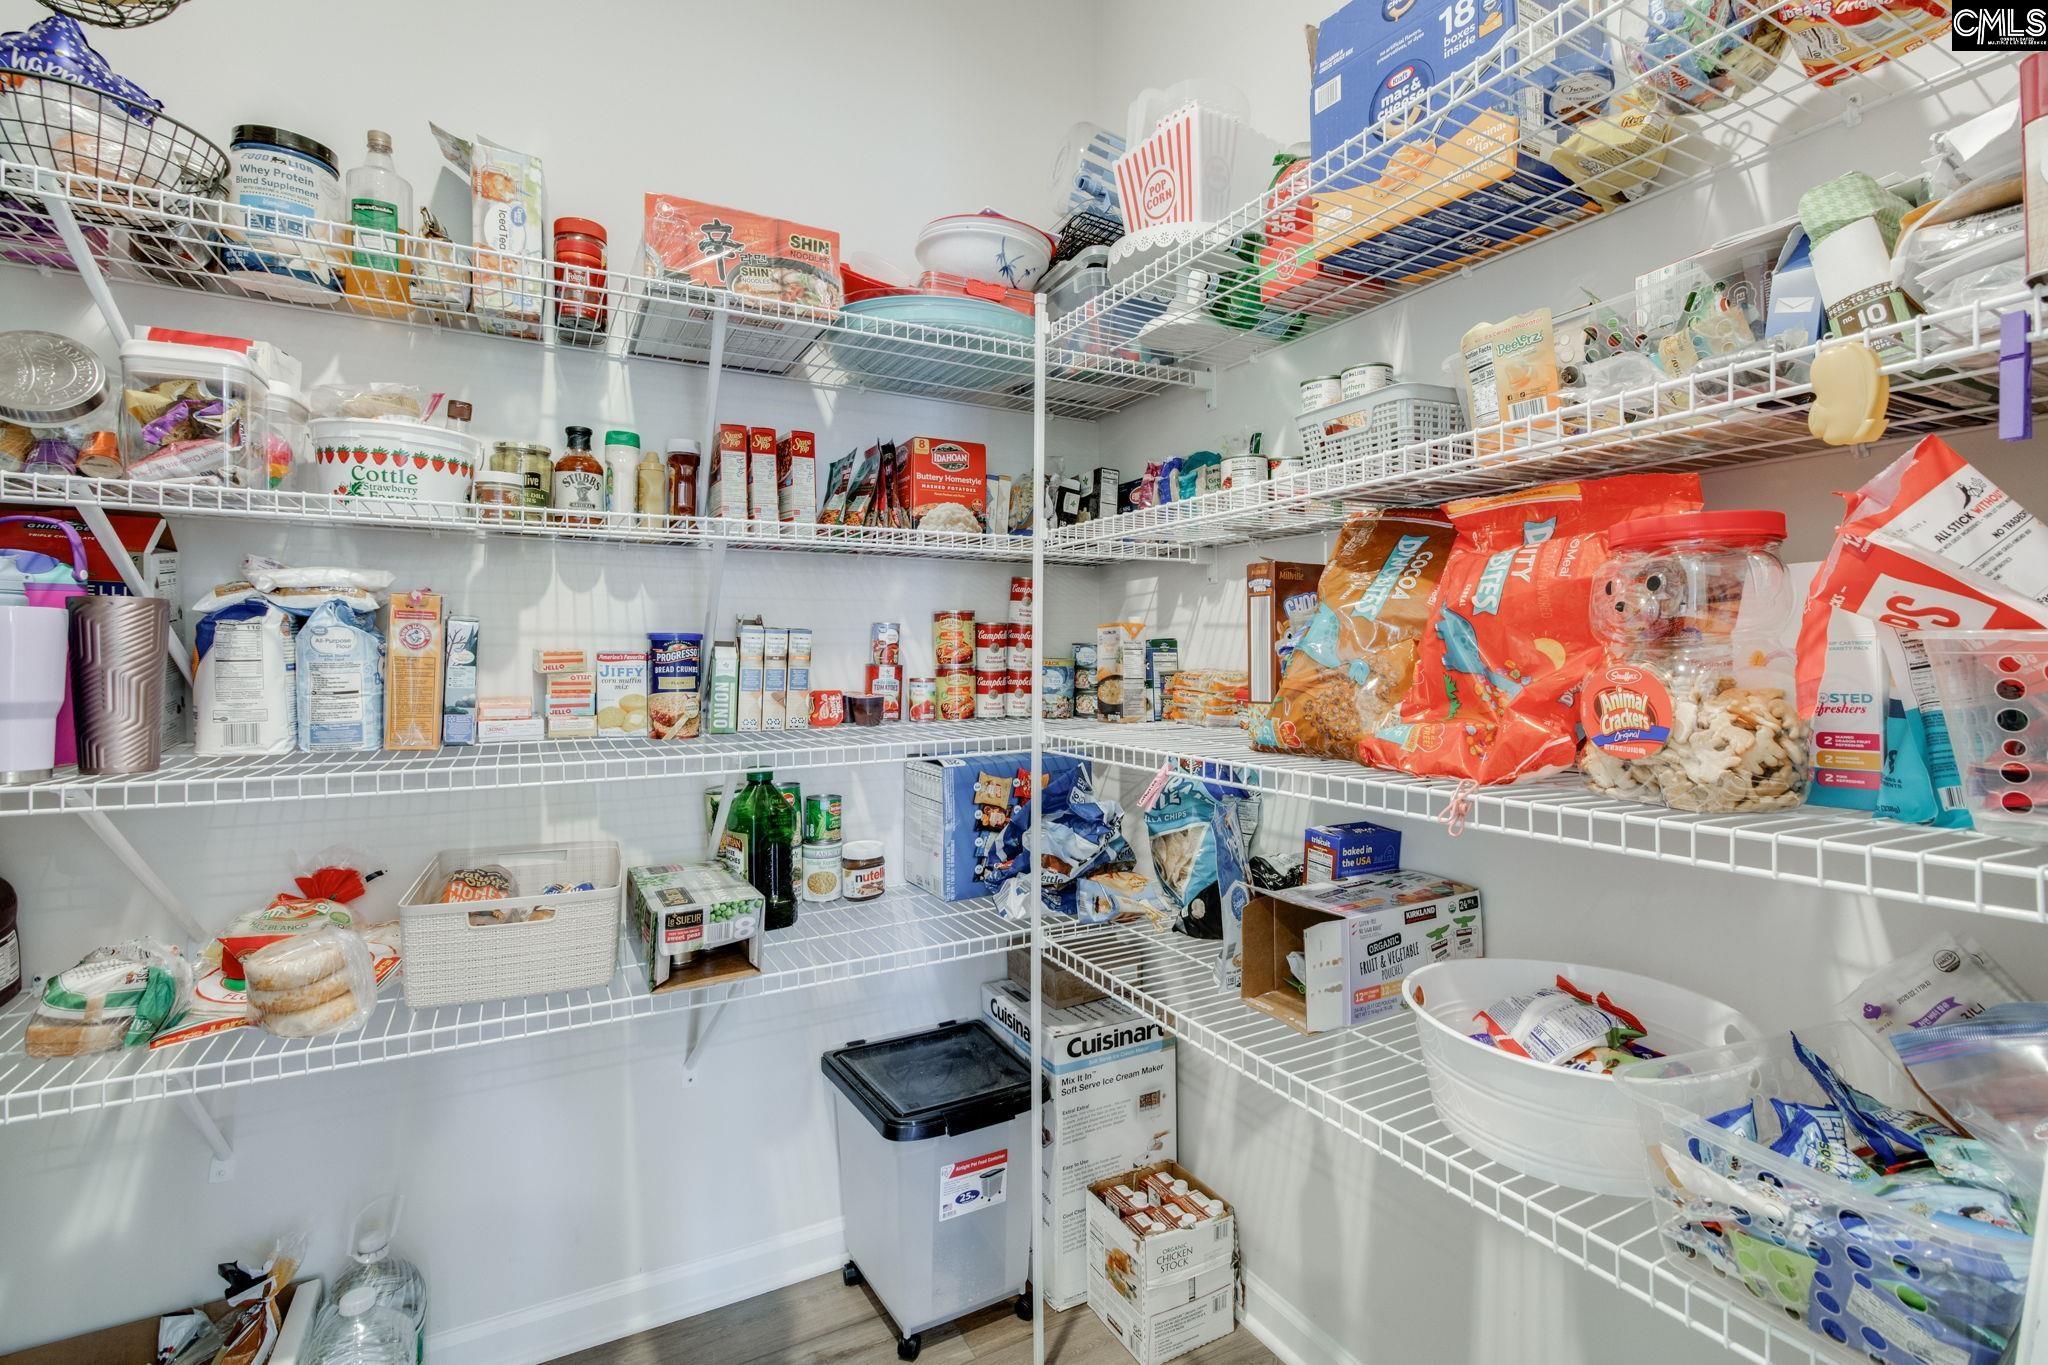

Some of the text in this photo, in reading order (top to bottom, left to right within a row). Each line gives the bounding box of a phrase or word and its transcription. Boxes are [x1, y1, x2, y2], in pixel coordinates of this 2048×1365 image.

[1438, 0, 1475, 35] 18
[1443, 24, 1475, 48] boxes
[1444, 34, 1476, 59] inside
[1392, 72, 1408, 83] Kraft
[1381, 77, 1421, 108] mac &
[1466, 121, 1507, 146] original
[1474, 133, 1507, 153] flavor
[241, 152, 314, 174] FOOD LION
[240, 164, 314, 187] Whey Protein
[236, 175, 319, 200] Blend Supplement
[1149, 178, 1167, 196] POP
[1146, 189, 1173, 210] CORN
[498, 208, 507, 251] Iced Tea
[789, 235, 830, 254] SHIN
[790, 251, 830, 264] NOODLES
[740, 266, 769, 278] SHIN
[1842, 303, 1887, 329] no. 10
[722, 432, 742, 445] Stove
[753, 435, 773, 448] Stove
[793, 438, 811, 450] Stove
[919, 440, 925, 448] 8
[934, 454, 967, 462] IDAHOAN
[351, 465, 418, 485] Cottle
[916, 472, 982, 486] Buttery Homestyle
[363, 482, 418, 495] Strawberry
[1934, 529, 1951, 544] ALL
[1947, 512, 1975, 533] STICK
[1992, 529, 2005, 539] NO
[1391, 551, 1433, 599] COCOA
[598, 654, 623, 662] America's
[657, 649, 698, 661] PROGRESSO
[713, 682, 730, 729] ONION
[1600, 686, 1648, 713] Animal
[1815, 702, 1867, 716] efreshers
[1602, 708, 1650, 735] Crackers
[1614, 730, 1640, 742] Original
[1824, 736, 1833, 745] 2
[1825, 755, 1833, 763] 2
[1825, 774, 1833, 782] 2
[1164, 811, 1188, 822] CHIPS
[1312, 836, 1331, 848] triscuit
[1343, 845, 1372, 856] baked in
[1342, 856, 1371, 868] the USA
[855, 865, 885, 883] nutell
[1041, 872, 1064, 883] ettle
[675, 913, 702, 925] SUEUR
[1405, 906, 1437, 919] KIRKLAND
[734, 917, 756, 939] 8
[667, 934, 685, 942] sweet
[1369, 935, 1400, 954] ORGANIC
[1360, 942, 1420, 976] FRUIT & VEGETABLE
[1381, 965, 1404, 980] POUCHES
[991, 998, 1031, 1043] Cuisina
[1066, 1022, 1165, 1058] Cuisinart
[1061, 1063, 1164, 1096] Soft Serve Ice Cream Maker
[1061, 1073, 1084, 1086] Mix It
[1062, 1163, 1074, 1171] Easy
[960, 1191, 971, 1202] 25
[1162, 1242, 1187, 1254] ORGANIC
[1156, 1246, 1193, 1265] CHICKEN
[1160, 1258, 1189, 1273] STOCK
